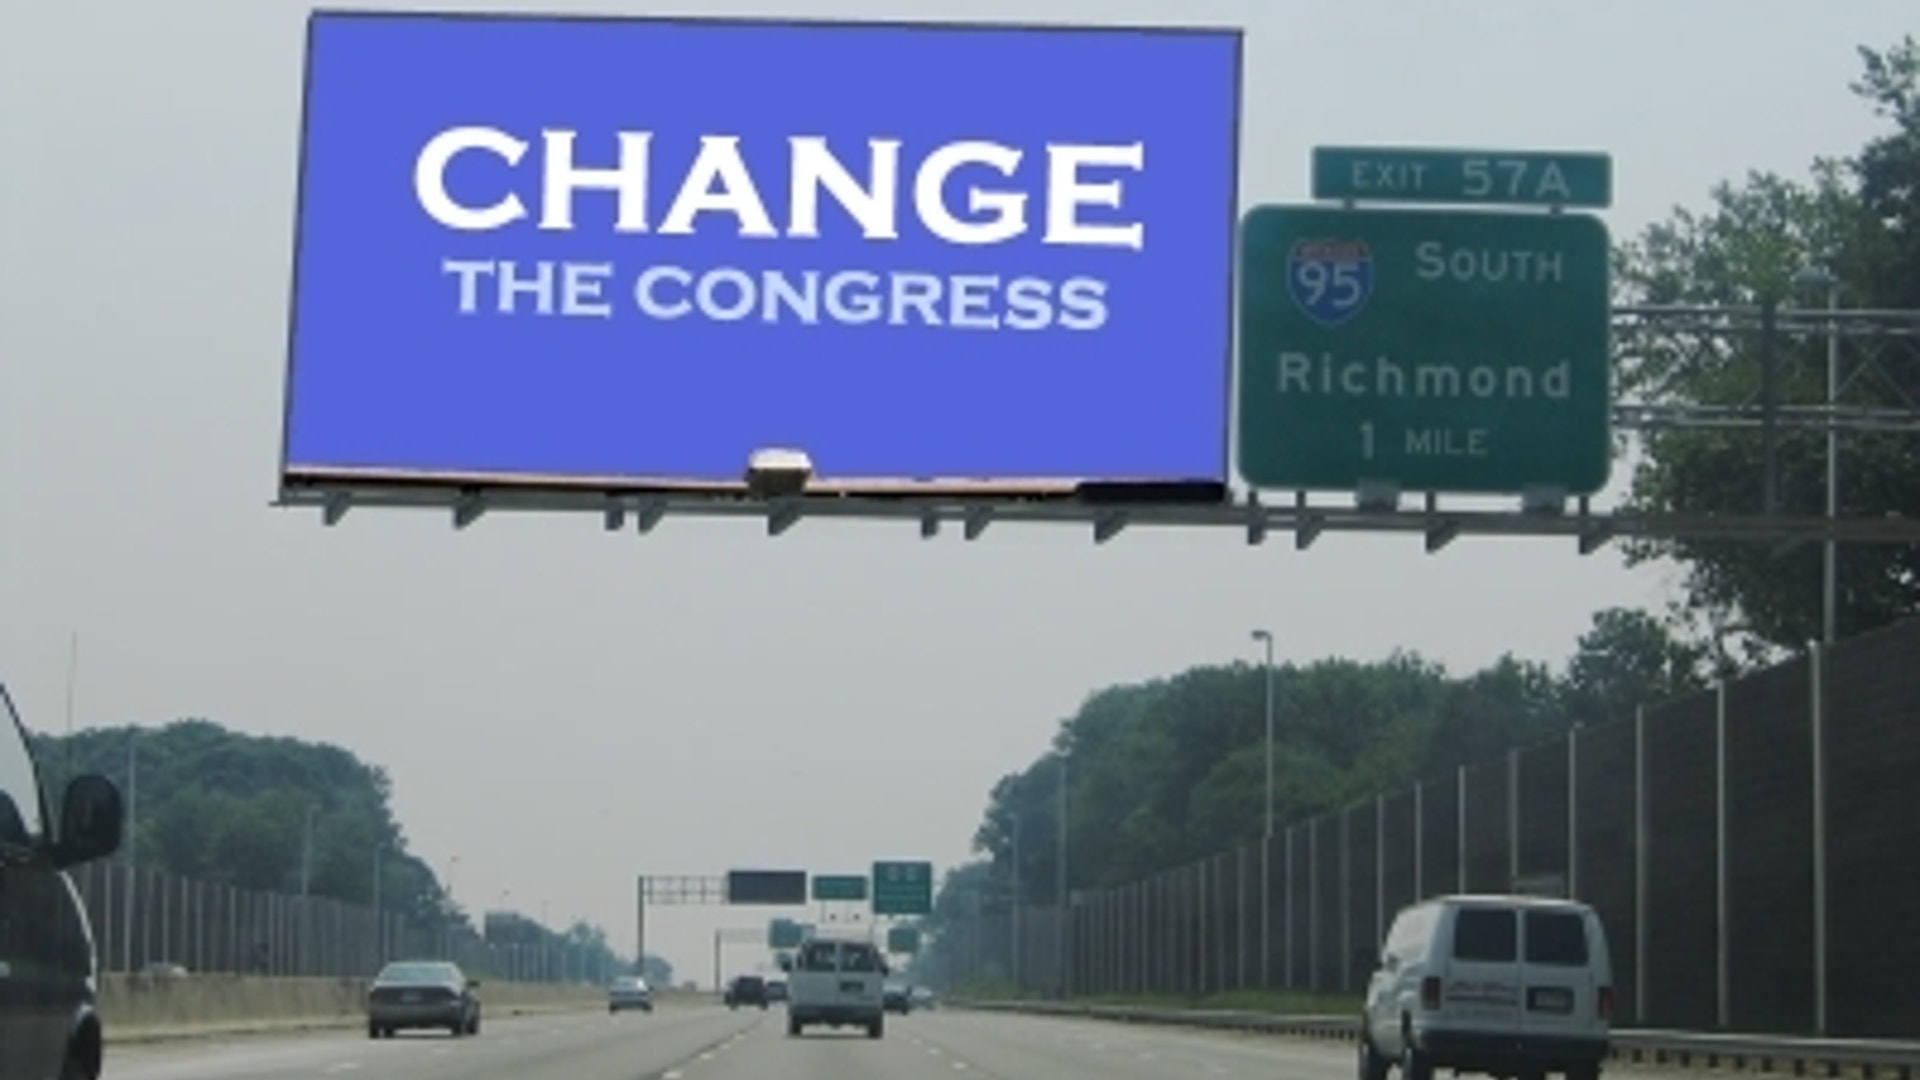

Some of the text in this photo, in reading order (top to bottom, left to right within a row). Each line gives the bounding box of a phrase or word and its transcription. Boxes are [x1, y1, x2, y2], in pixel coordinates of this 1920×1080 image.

[413, 125, 1145, 251] CHANGE
[1351, 159, 1571, 198] EXIT 57A
[1297, 260, 1362, 307] 95
[1415, 241, 1563, 283] SOUTH
[442, 258, 1110, 332] THE CONGRESS
[1277, 351, 1572, 398] Richmond
[1359, 421, 1490, 459] 1 MILE
